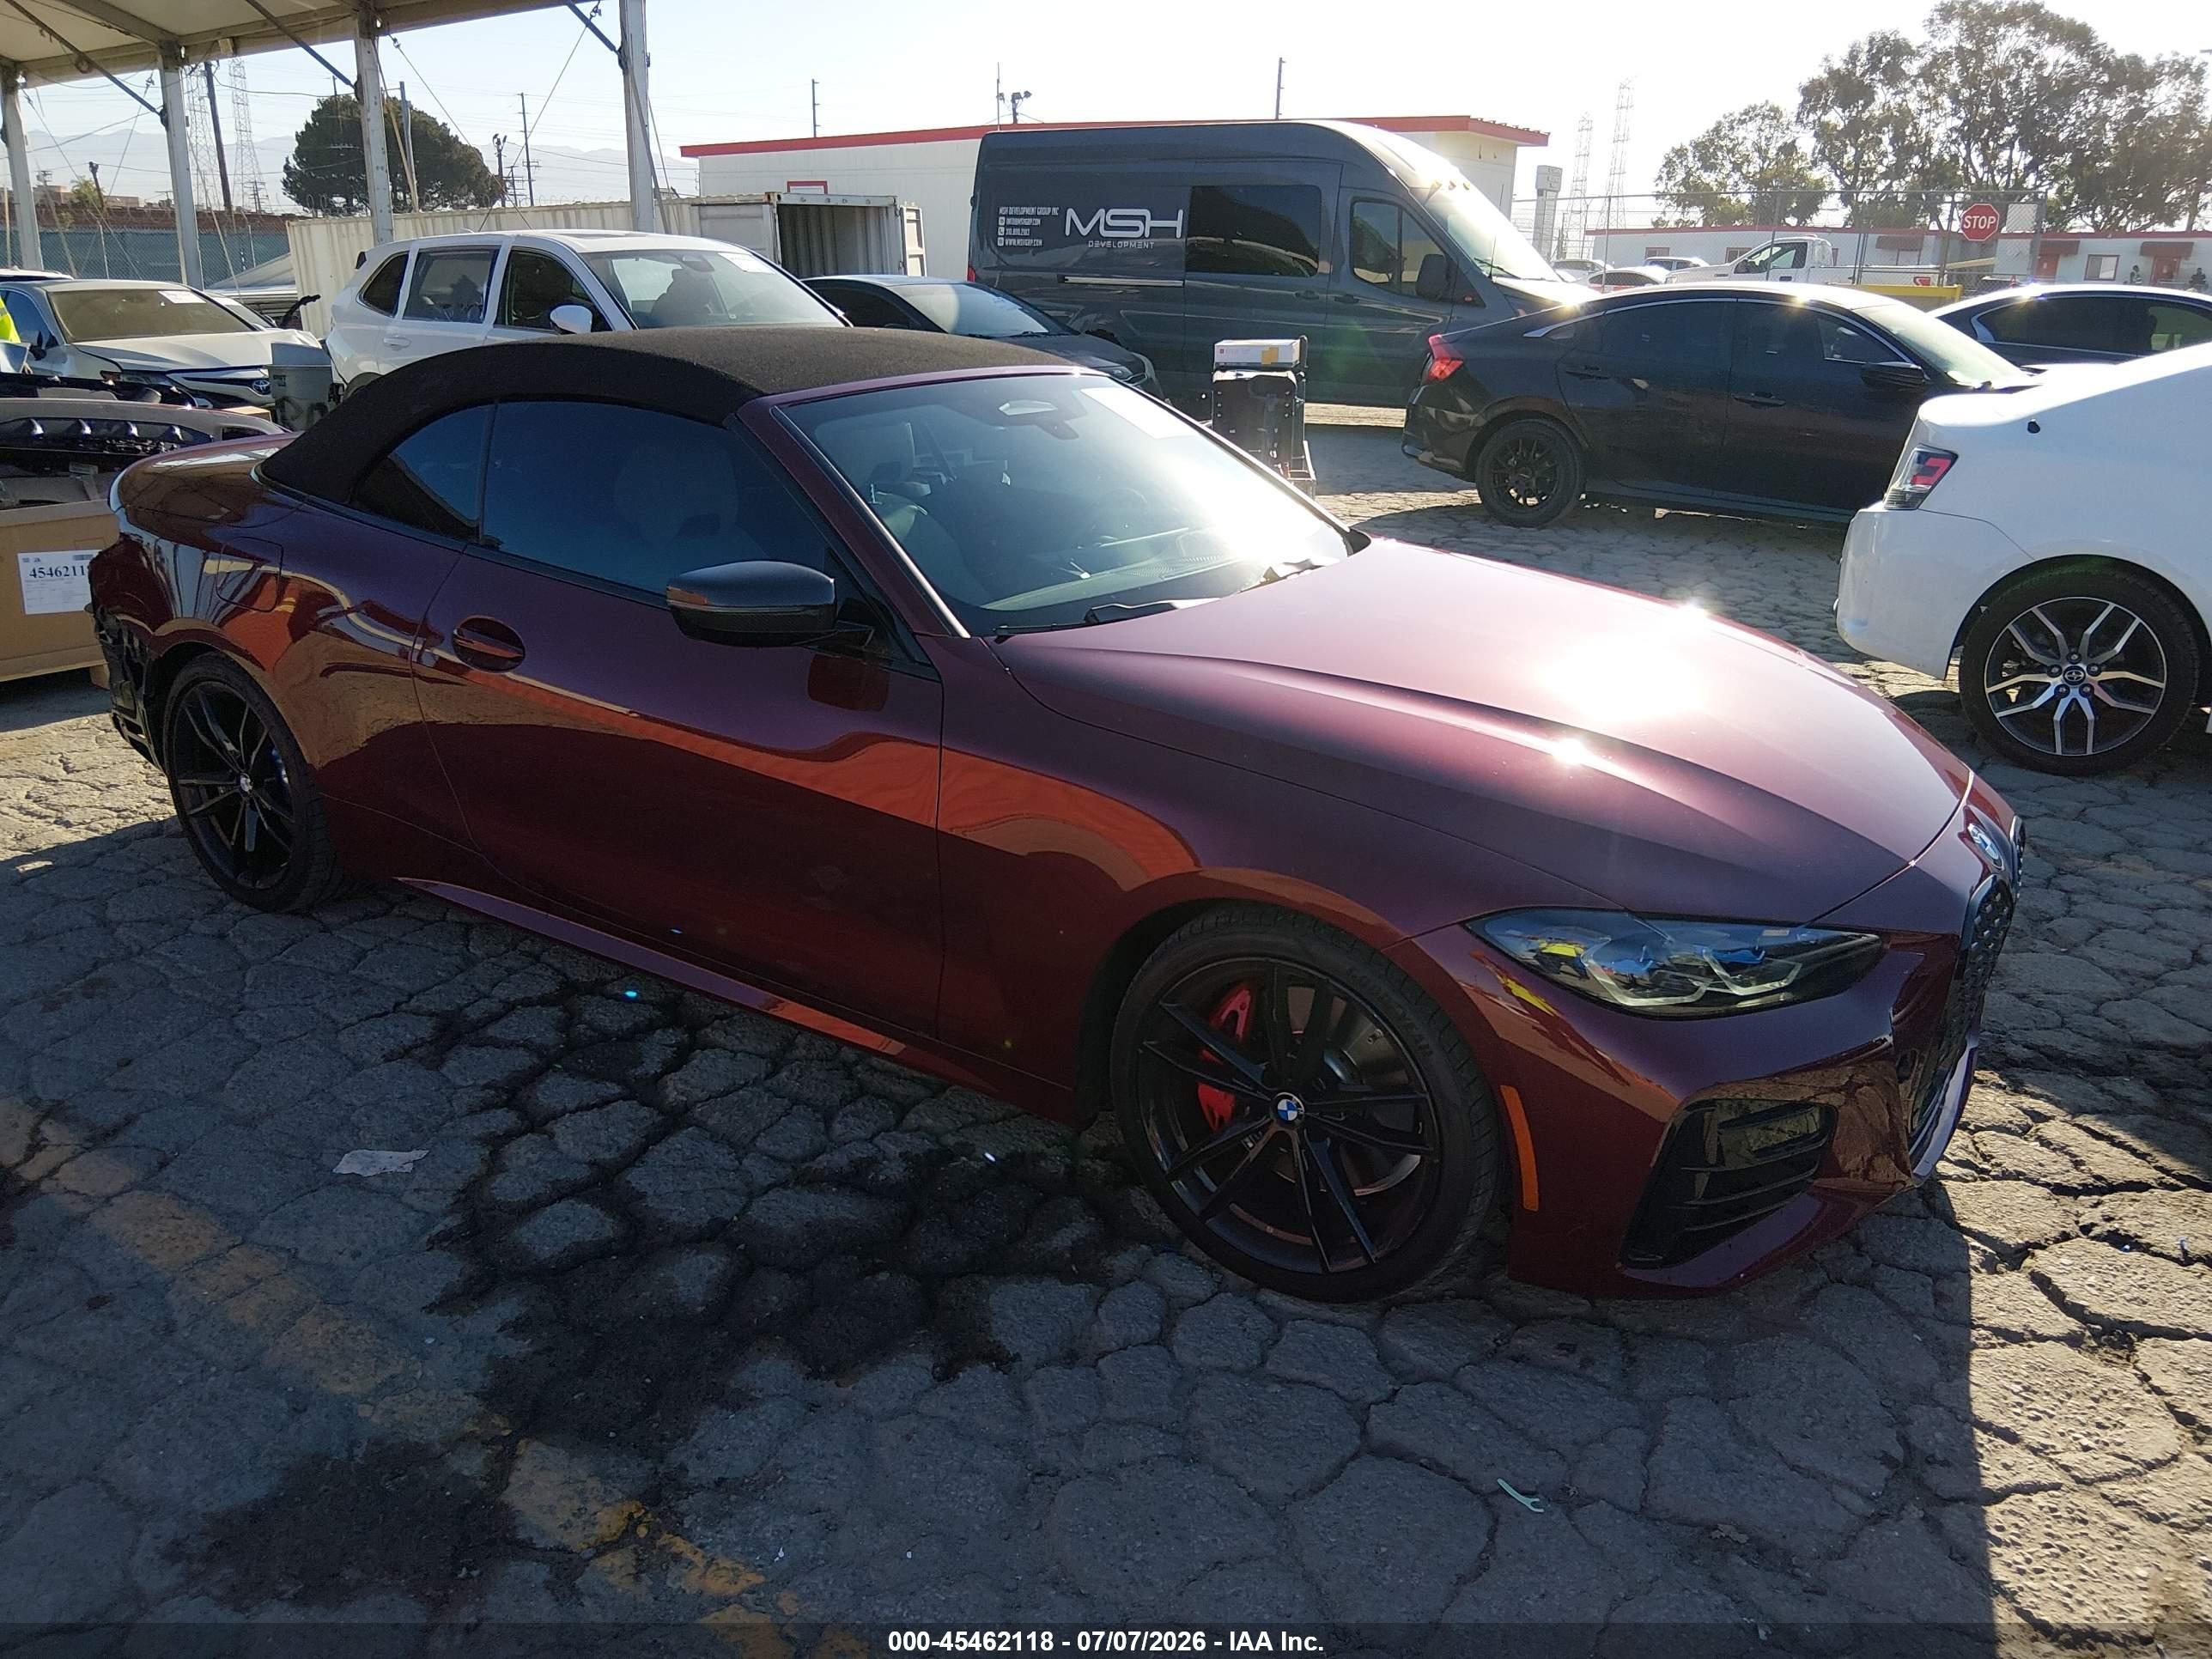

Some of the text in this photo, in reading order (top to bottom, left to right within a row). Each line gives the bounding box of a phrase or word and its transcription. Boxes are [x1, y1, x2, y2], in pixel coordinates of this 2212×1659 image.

[1008, 206, 1036, 216] DEVELOPMENT
[1065, 208, 1183, 239] MSH
[1963, 215, 1996, 229] STOP
[1088, 240, 1154, 249] DEVELOPMENT
[29, 565, 86, 579] 4546211
